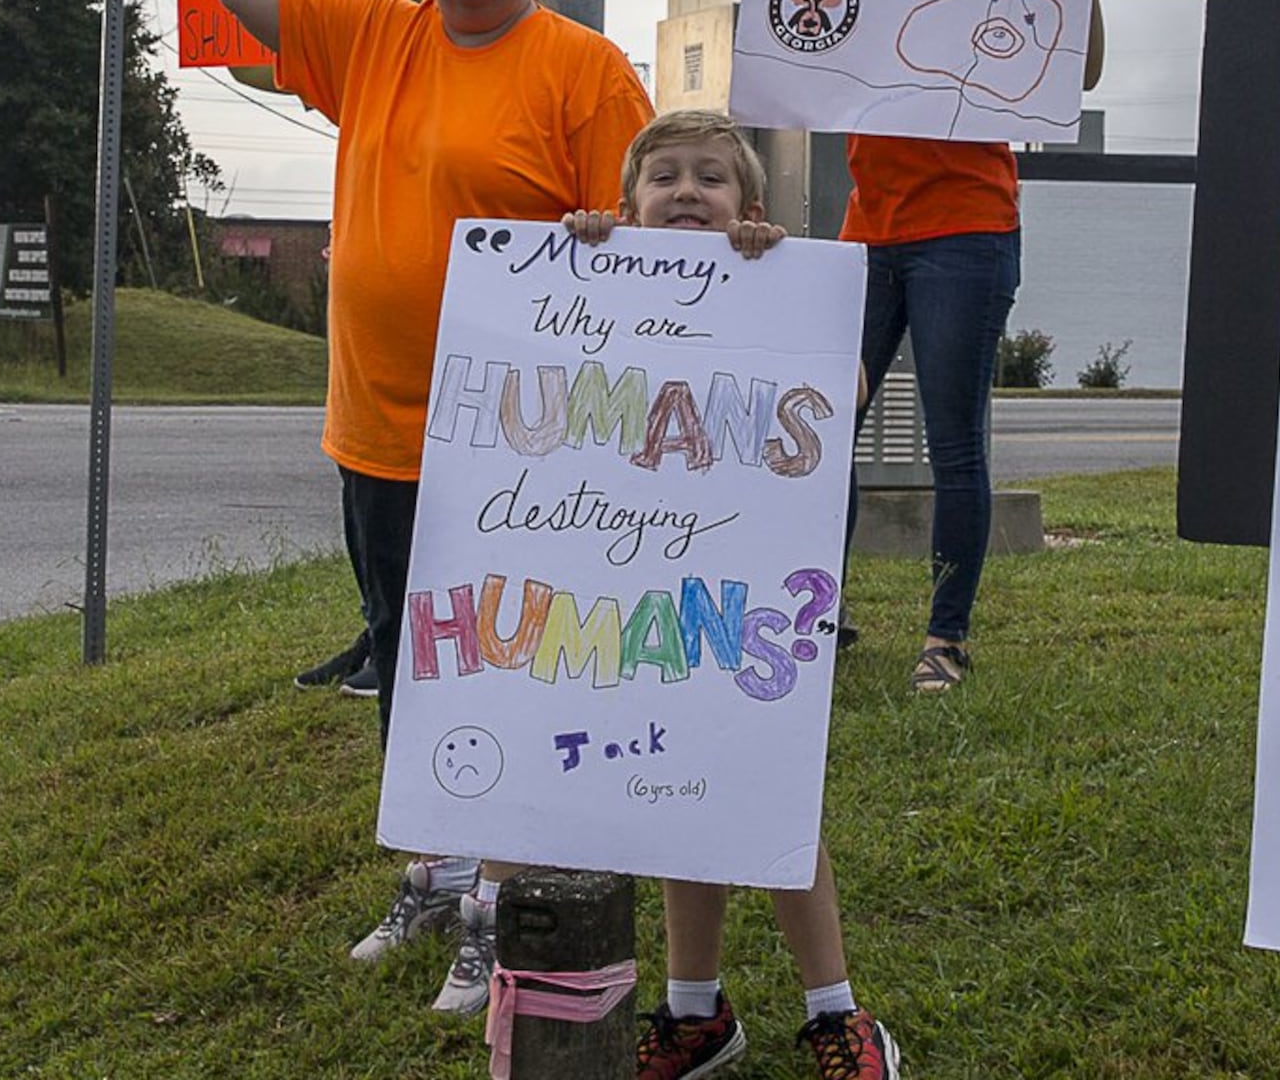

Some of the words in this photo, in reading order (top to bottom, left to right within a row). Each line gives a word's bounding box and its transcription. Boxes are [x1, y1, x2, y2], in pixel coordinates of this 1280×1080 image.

[775, 24, 843, 50] GEORGIA
[530, 295, 618, 354] Why
[634, 310, 713, 339] are
[426, 352, 834, 479] HUMANS
[477, 468, 740, 566] destroying
[553, 721, 667, 773] Jack
